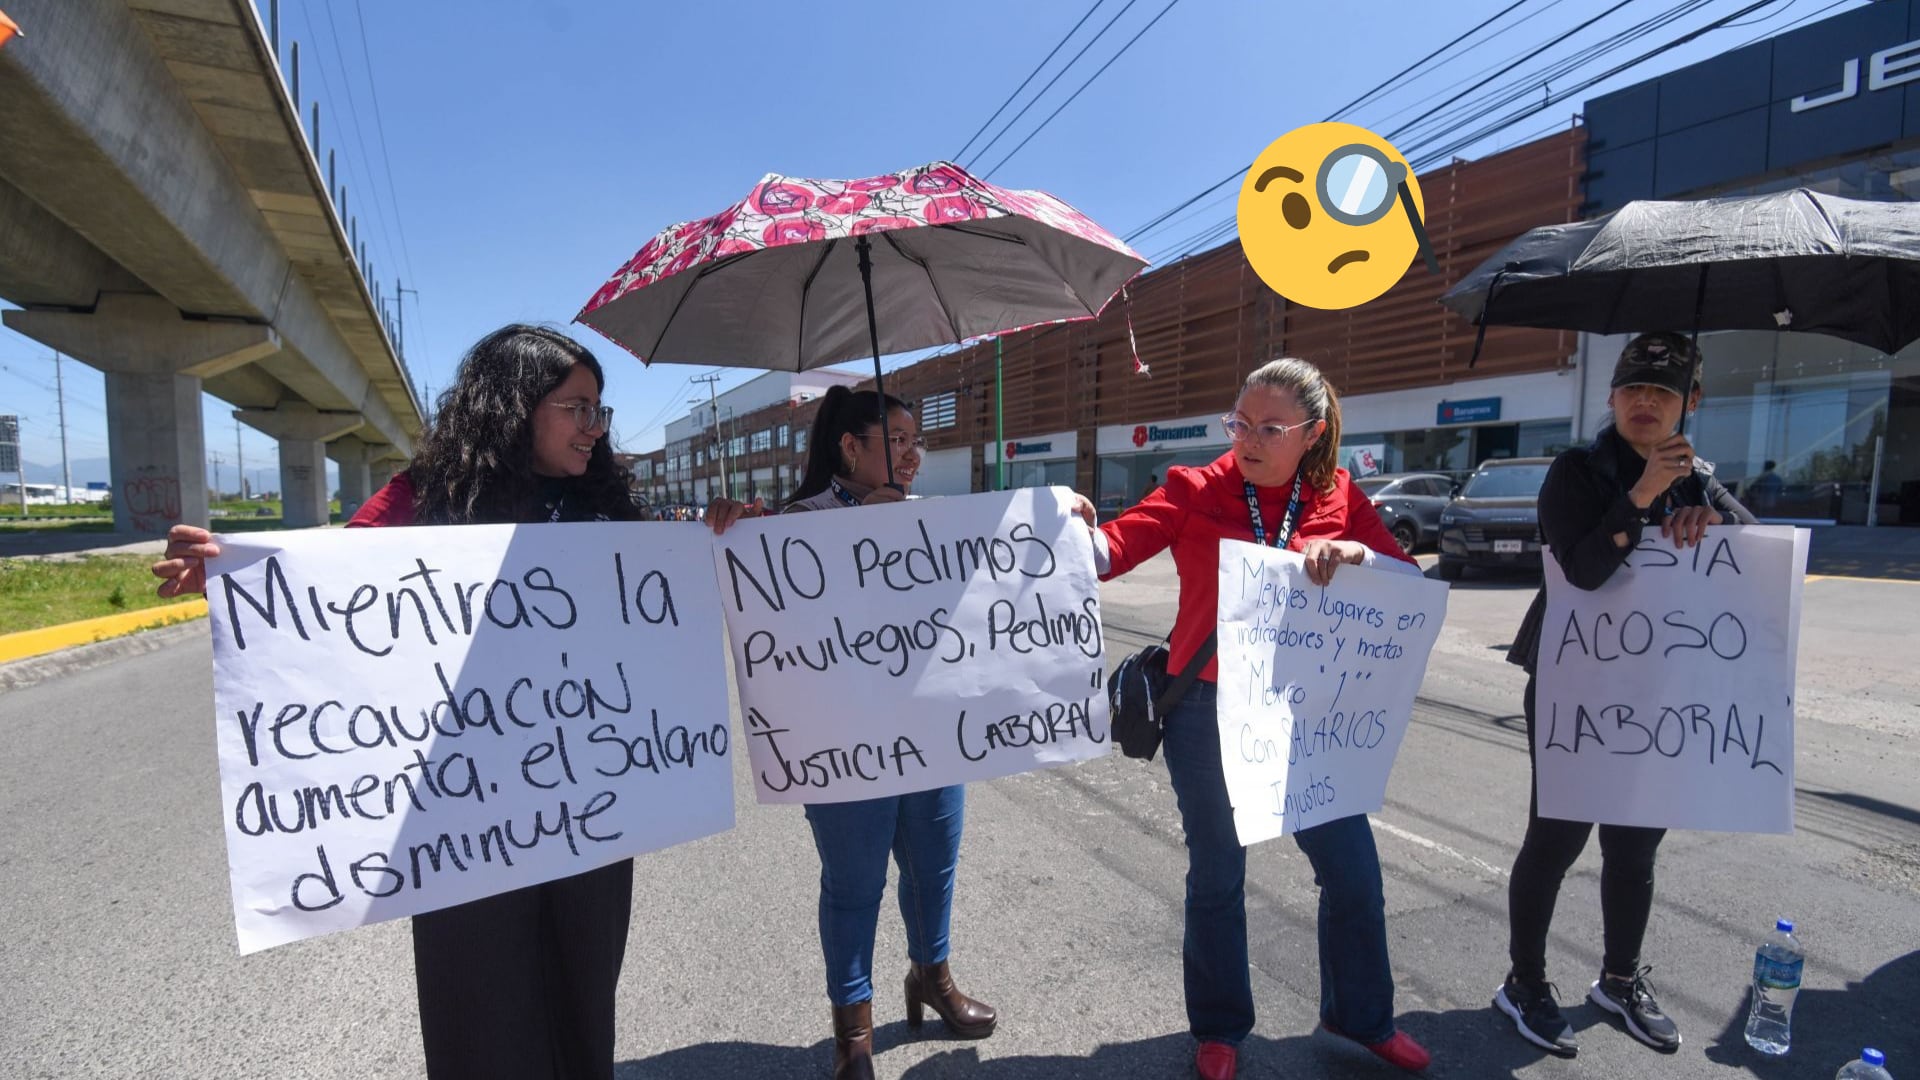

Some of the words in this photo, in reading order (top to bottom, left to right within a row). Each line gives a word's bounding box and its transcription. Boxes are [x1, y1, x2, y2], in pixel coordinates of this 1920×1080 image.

[1148, 424, 1208, 442] Banamex
[1248, 496, 1263, 527] SAT
[1280, 510, 1293, 541] SAT
[725, 533, 826, 613] NO
[1241, 557, 1308, 624] Mejores
[1317, 585, 1384, 634] lugares
[1397, 612, 1426, 631] en
[222, 556, 577, 656] Mientras
[614, 552, 679, 628] la
[1238, 616, 1324, 650] indicadores
[1333, 636, 1346, 662] y
[1357, 636, 1403, 660] metas
[1556, 609, 1747, 665] ACOSO
[520, 726, 577, 789] el
[1240, 723, 1278, 764] Con
[1281, 709, 1387, 766] SALARIOS
[1270, 773, 1336, 832] Injustos
